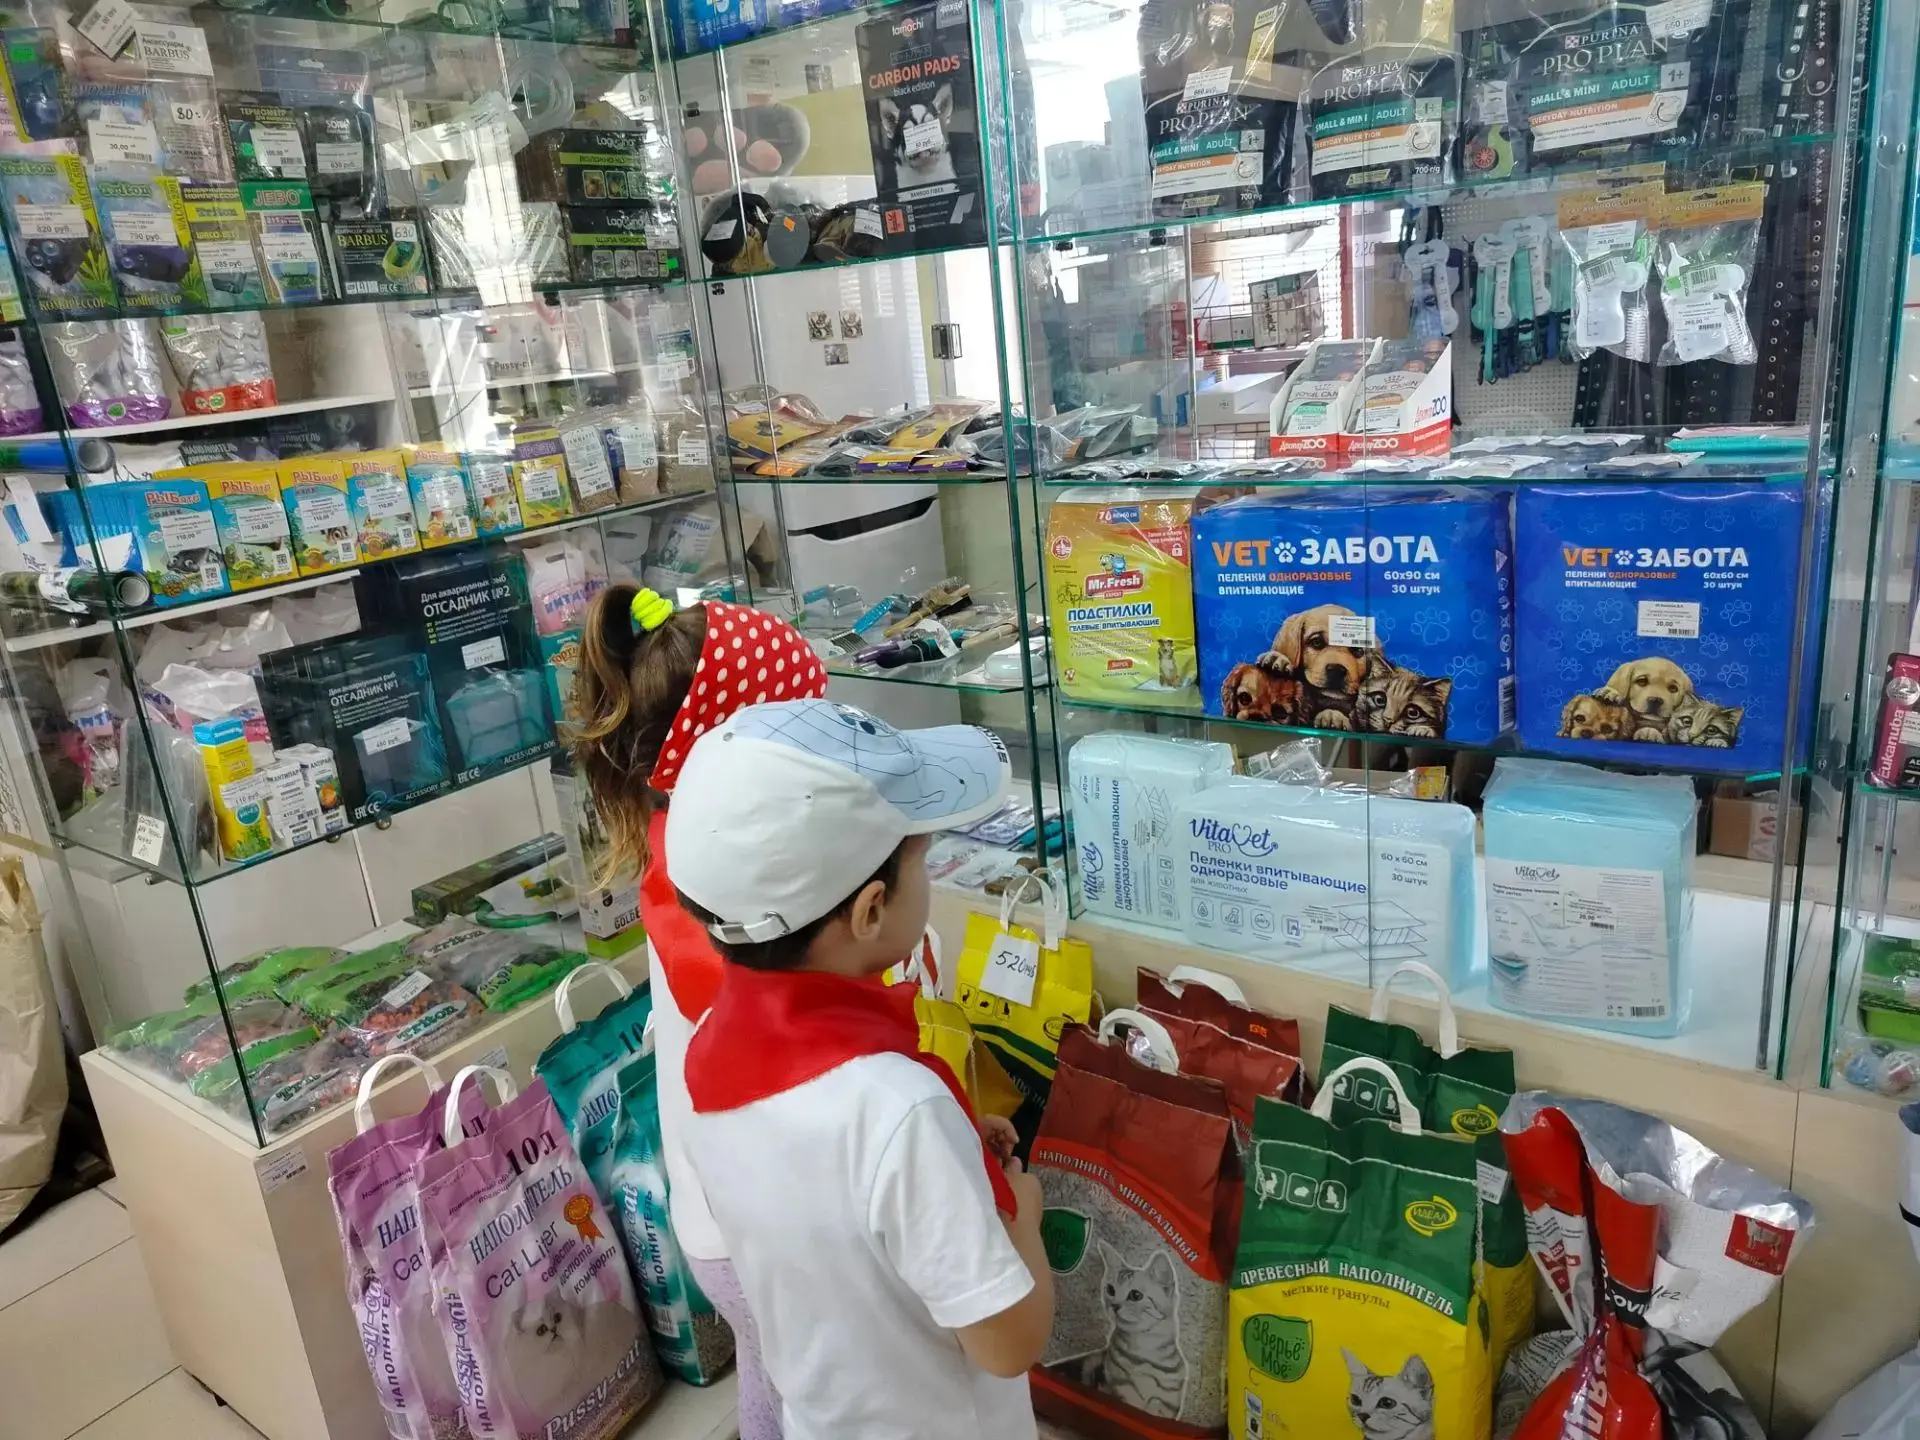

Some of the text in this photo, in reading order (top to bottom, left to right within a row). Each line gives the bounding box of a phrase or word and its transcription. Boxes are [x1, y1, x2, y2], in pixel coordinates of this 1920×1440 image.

[1581, 25, 1641, 45] PURINA
[145, 47, 190, 60] BARBUS
[869, 64, 920, 89] CARBON
[924, 55, 961, 76] PADS
[1352, 62, 1400, 78] PURINA
[1542, 52, 1591, 77] PRO
[912, 81, 936, 93] edition
[1323, 84, 1364, 105] PRO
[1530, 91, 1561, 106] SMALL
[1573, 85, 1600, 97] MINI
[1611, 75, 1651, 91] ADULT
[1187, 95, 1230, 110] PURINA
[1315, 118, 1338, 133] SMALL
[1346, 113, 1367, 126] MINI
[1376, 107, 1408, 120] ADULT
[1531, 103, 1618, 125] EVERYDAY NUTRITION
[1160, 114, 1196, 135] PRO
[1180, 143, 1199, 154] MINI
[1206, 137, 1233, 149] ADULT
[254, 189, 300, 206] JEBO
[337, 233, 389, 247] BARBUS
[1212, 540, 1271, 567] VET
[1300, 536, 1439, 566] ЗАБОТА
[1563, 547, 1614, 567] VET
[1636, 547, 1749, 567] ЗАБОТА
[1088, 574, 1141, 591] Mr.Fresh
[1217, 571, 1352, 583] ПЕЛЕНКИ ОДНОРАЗОВЫЕ
[1565, 571, 1678, 580] ПЕЛЕНКИ ОДНОРАЗОВЫЕ
[1565, 580, 1638, 590] ВПИТЫВАЮЩИЕ
[1703, 581, 1717, 590] 30
[421, 580, 490, 603] Для аквариумных
[1218, 585, 1305, 596] ВПИТЫВАЮЩИЕ
[1391, 584, 1441, 596] 30 штук
[423, 589, 491, 617] ОТСАДНИК
[1068, 602, 1153, 622] ПОДСТИЛКИ
[1069, 618, 1161, 632] ГЕЛЕВЫЕ ВПИТЫВАЮЩИЕ
[330, 684, 384, 707] ОТСАДНИК
[1208, 841, 1232, 854] PRO
[1381, 853, 1428, 867] 60 60 см
[1120, 839, 1134, 912] одноразовые
[1190, 851, 1367, 894] Пеленки впитывающие
[1190, 863, 1289, 891] одноразовые
[1190, 876, 1206, 886] для
[1391, 873, 1403, 882] 30
[505, 1129, 559, 1177] 10л
[1117, 1183, 1199, 1263] МИНЕРАЛЬНЫЙ
[1412, 1207, 1449, 1223] ИДЕАЛ
[573, 1245, 617, 1295] комфорт
[485, 1264, 521, 1300] Cat
[1239, 1260, 1454, 1317] ДРЕВЕСНЫЙ НАПОЛНИТЕЛЬ
[1332, 1287, 1390, 1310] гранулы
[544, 1340, 642, 1440] Pussy-cat
